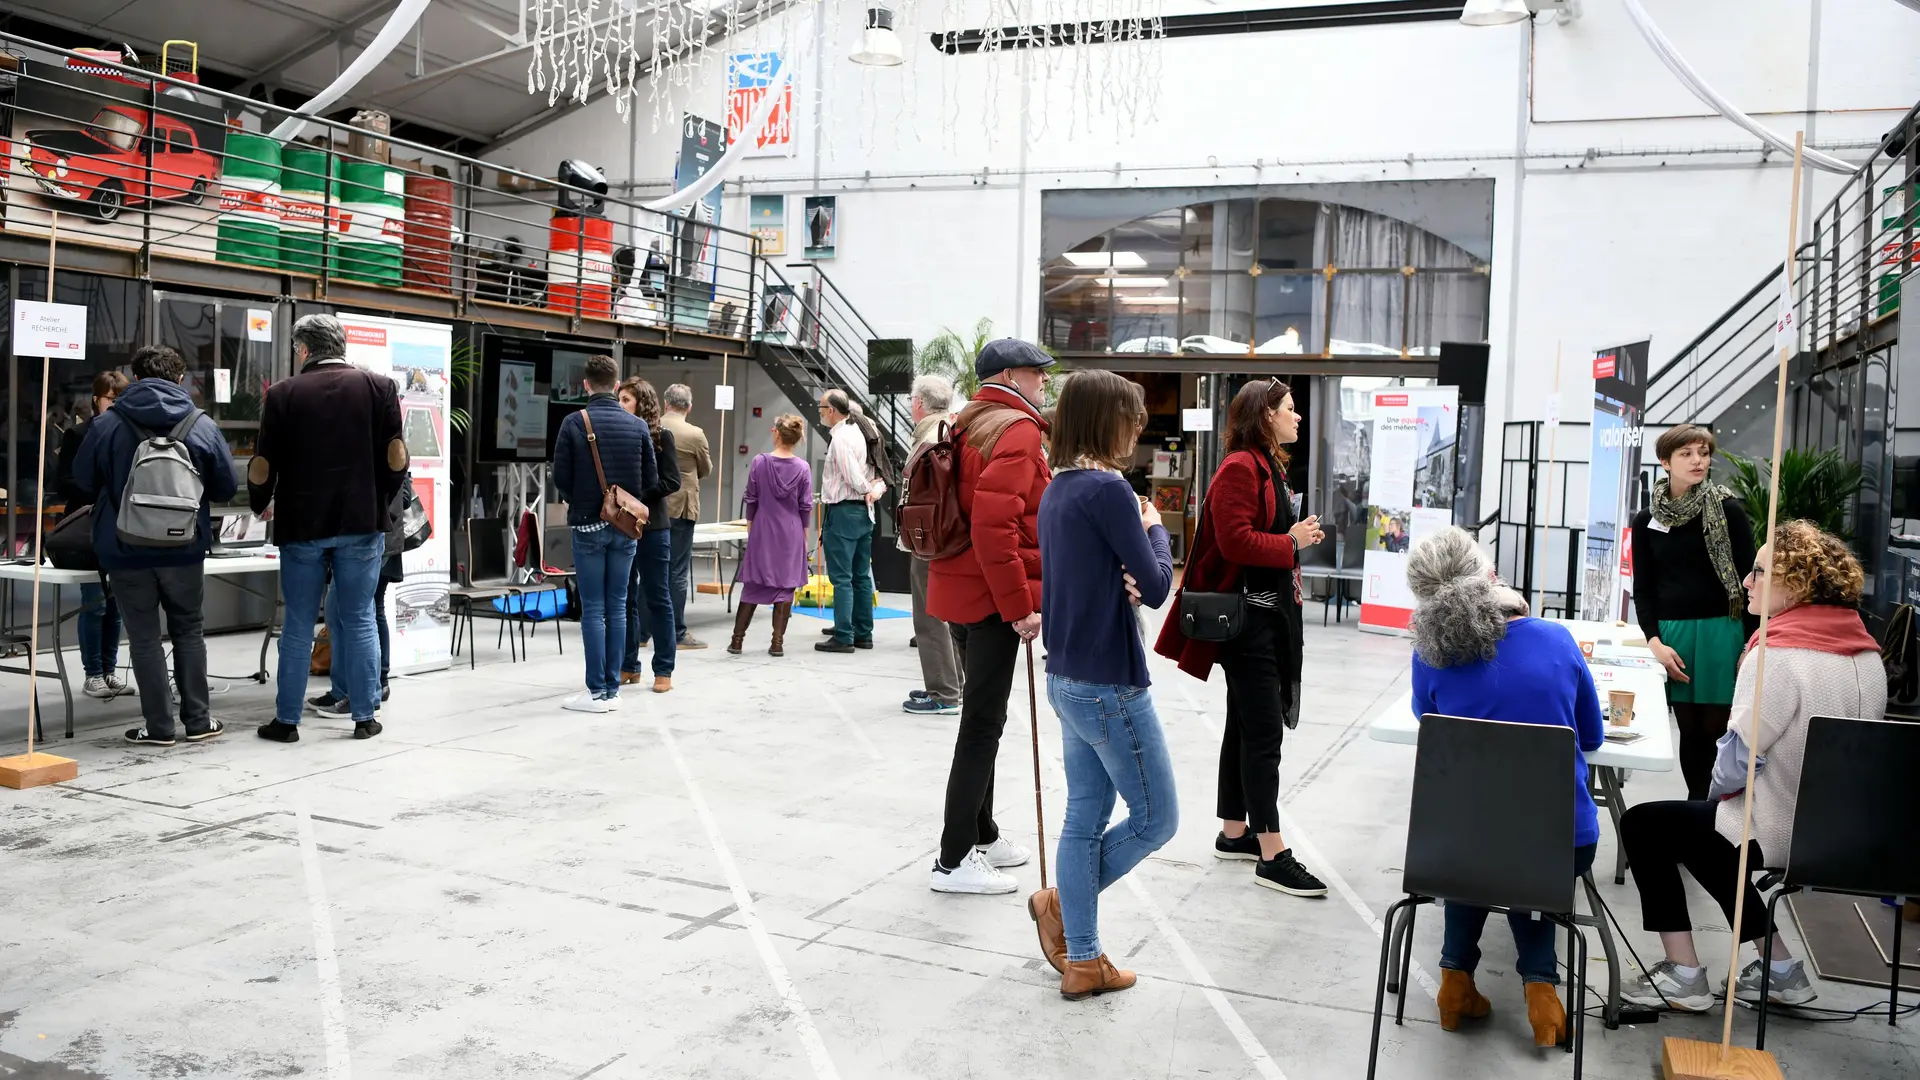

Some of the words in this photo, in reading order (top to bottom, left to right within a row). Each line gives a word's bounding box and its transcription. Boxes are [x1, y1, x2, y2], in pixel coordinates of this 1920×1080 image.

[40, 315, 60, 323] Atelier
[32, 324, 68, 334] RECHERCHE
[1599, 422, 1644, 448] valoriser
